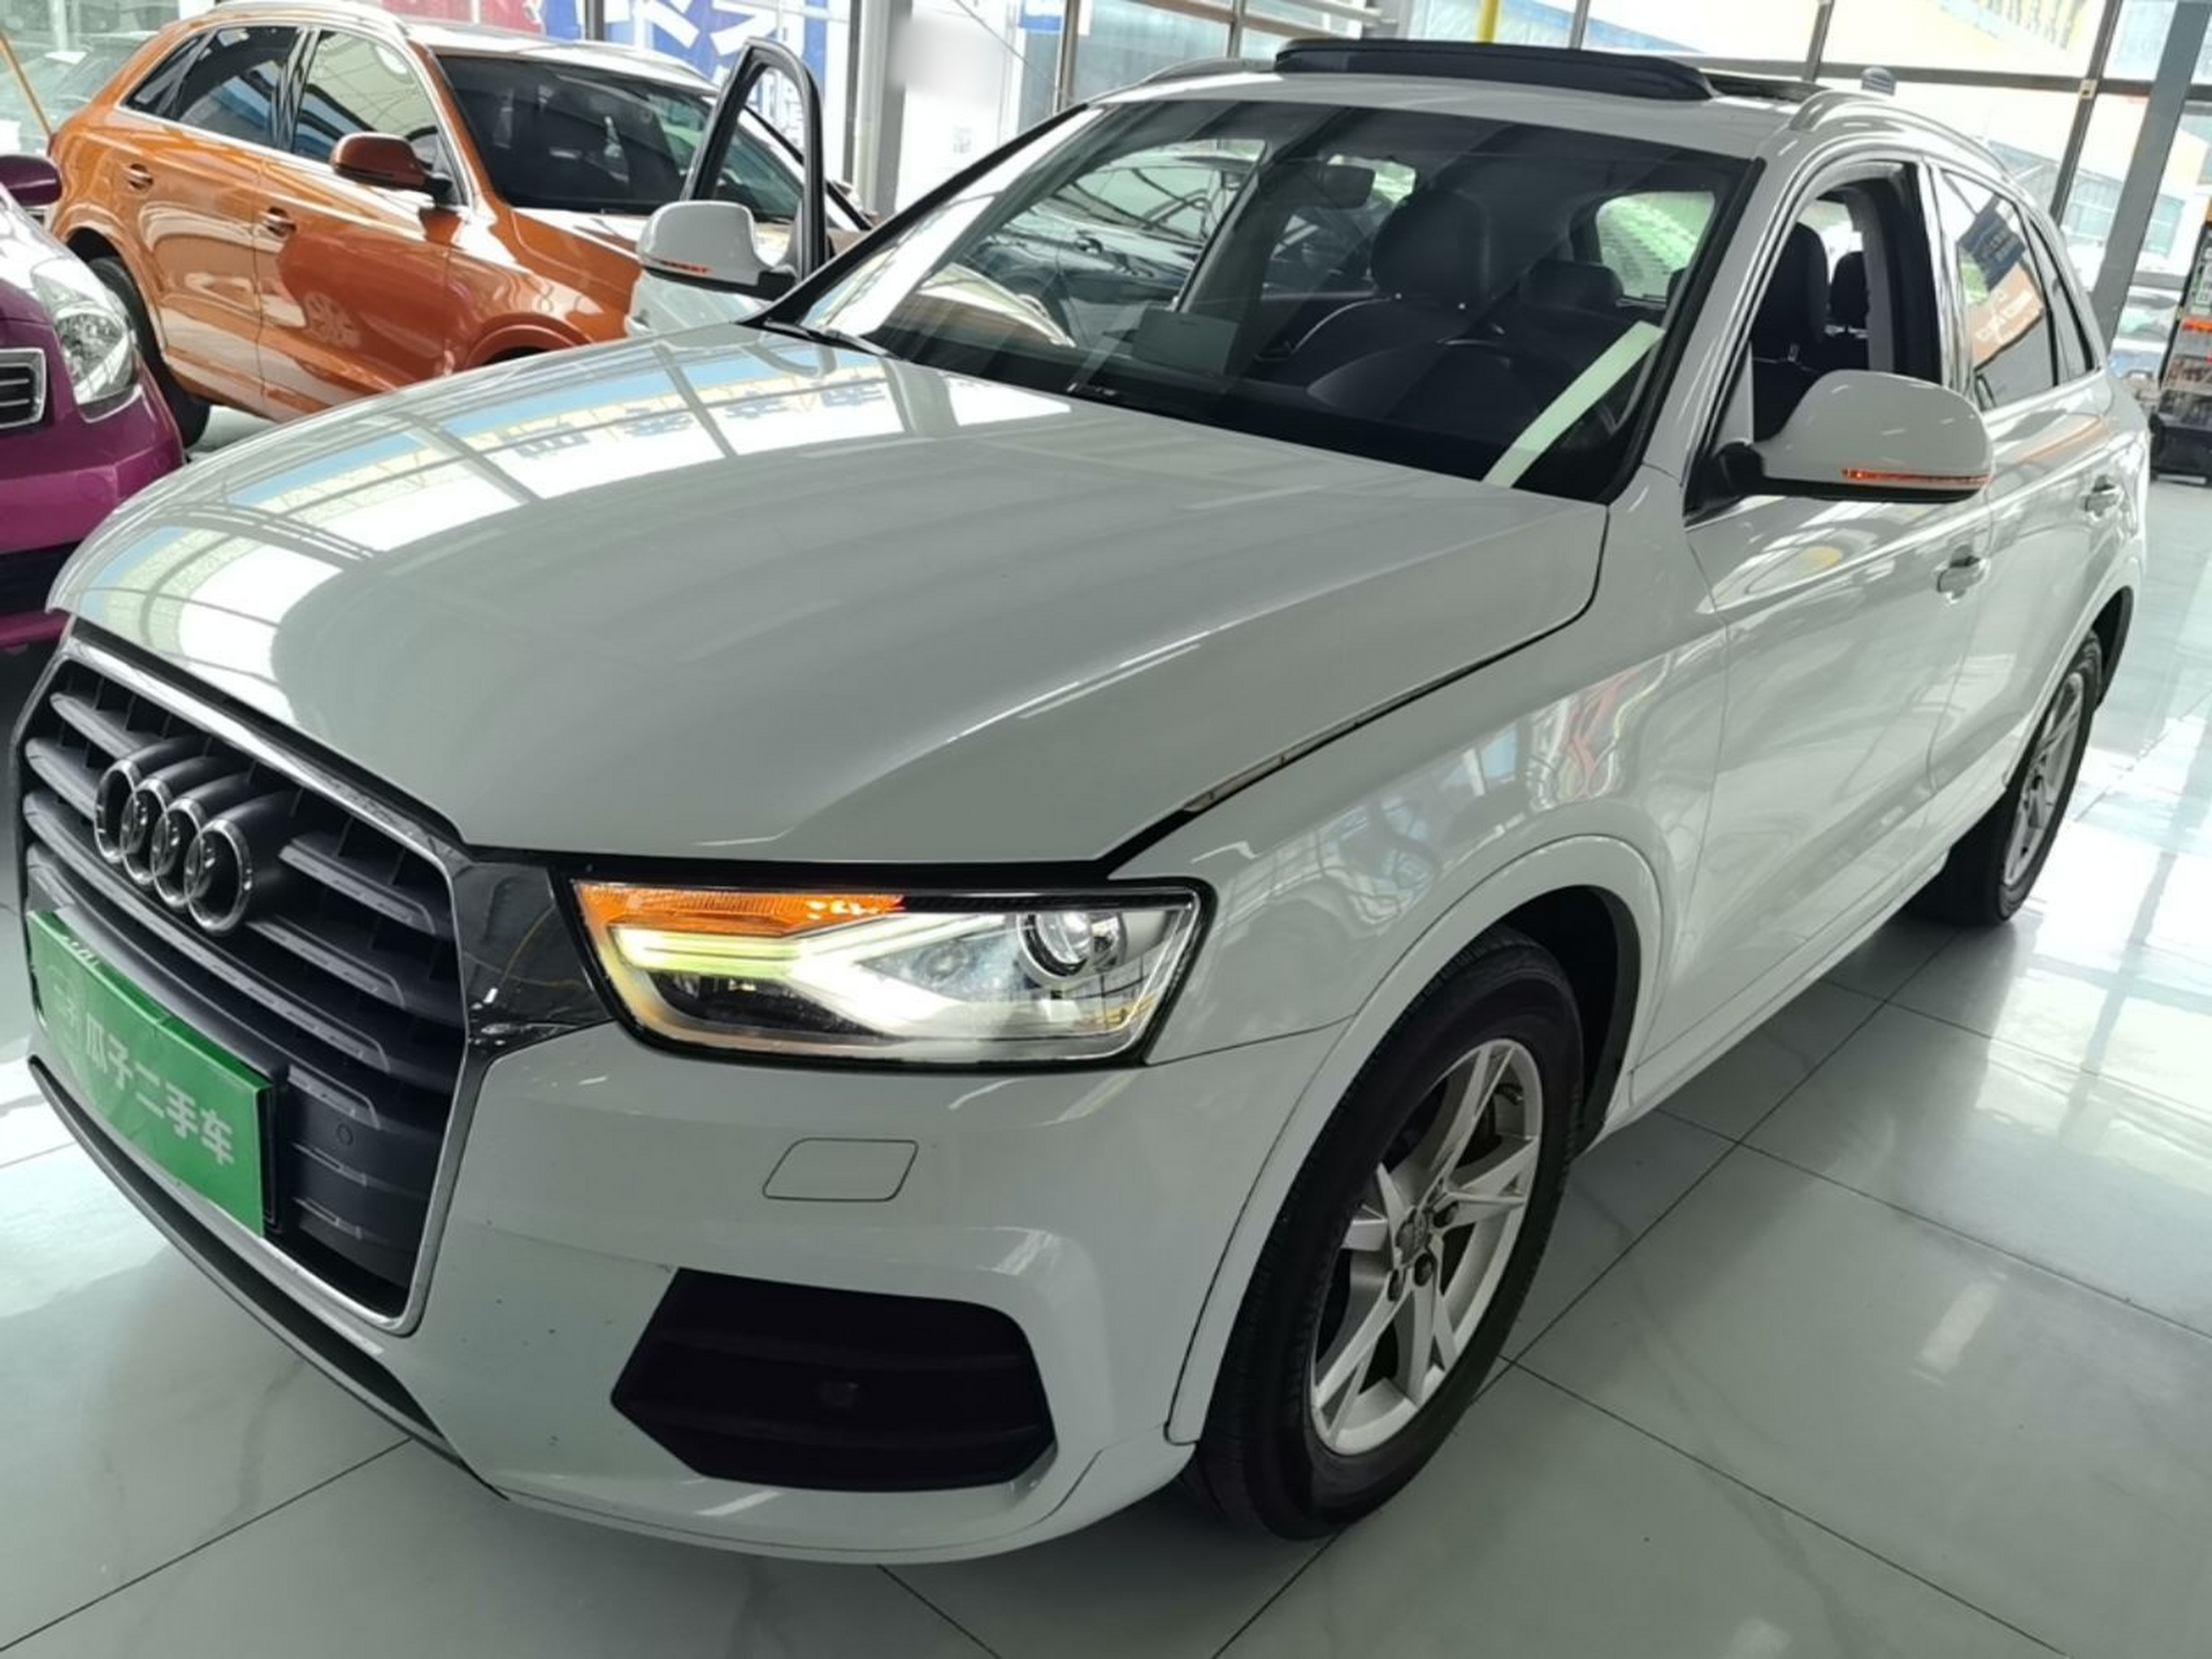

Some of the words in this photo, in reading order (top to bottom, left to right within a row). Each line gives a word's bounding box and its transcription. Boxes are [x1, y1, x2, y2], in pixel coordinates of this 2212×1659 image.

[86, 1012, 234, 1165] 瓜子二手车
